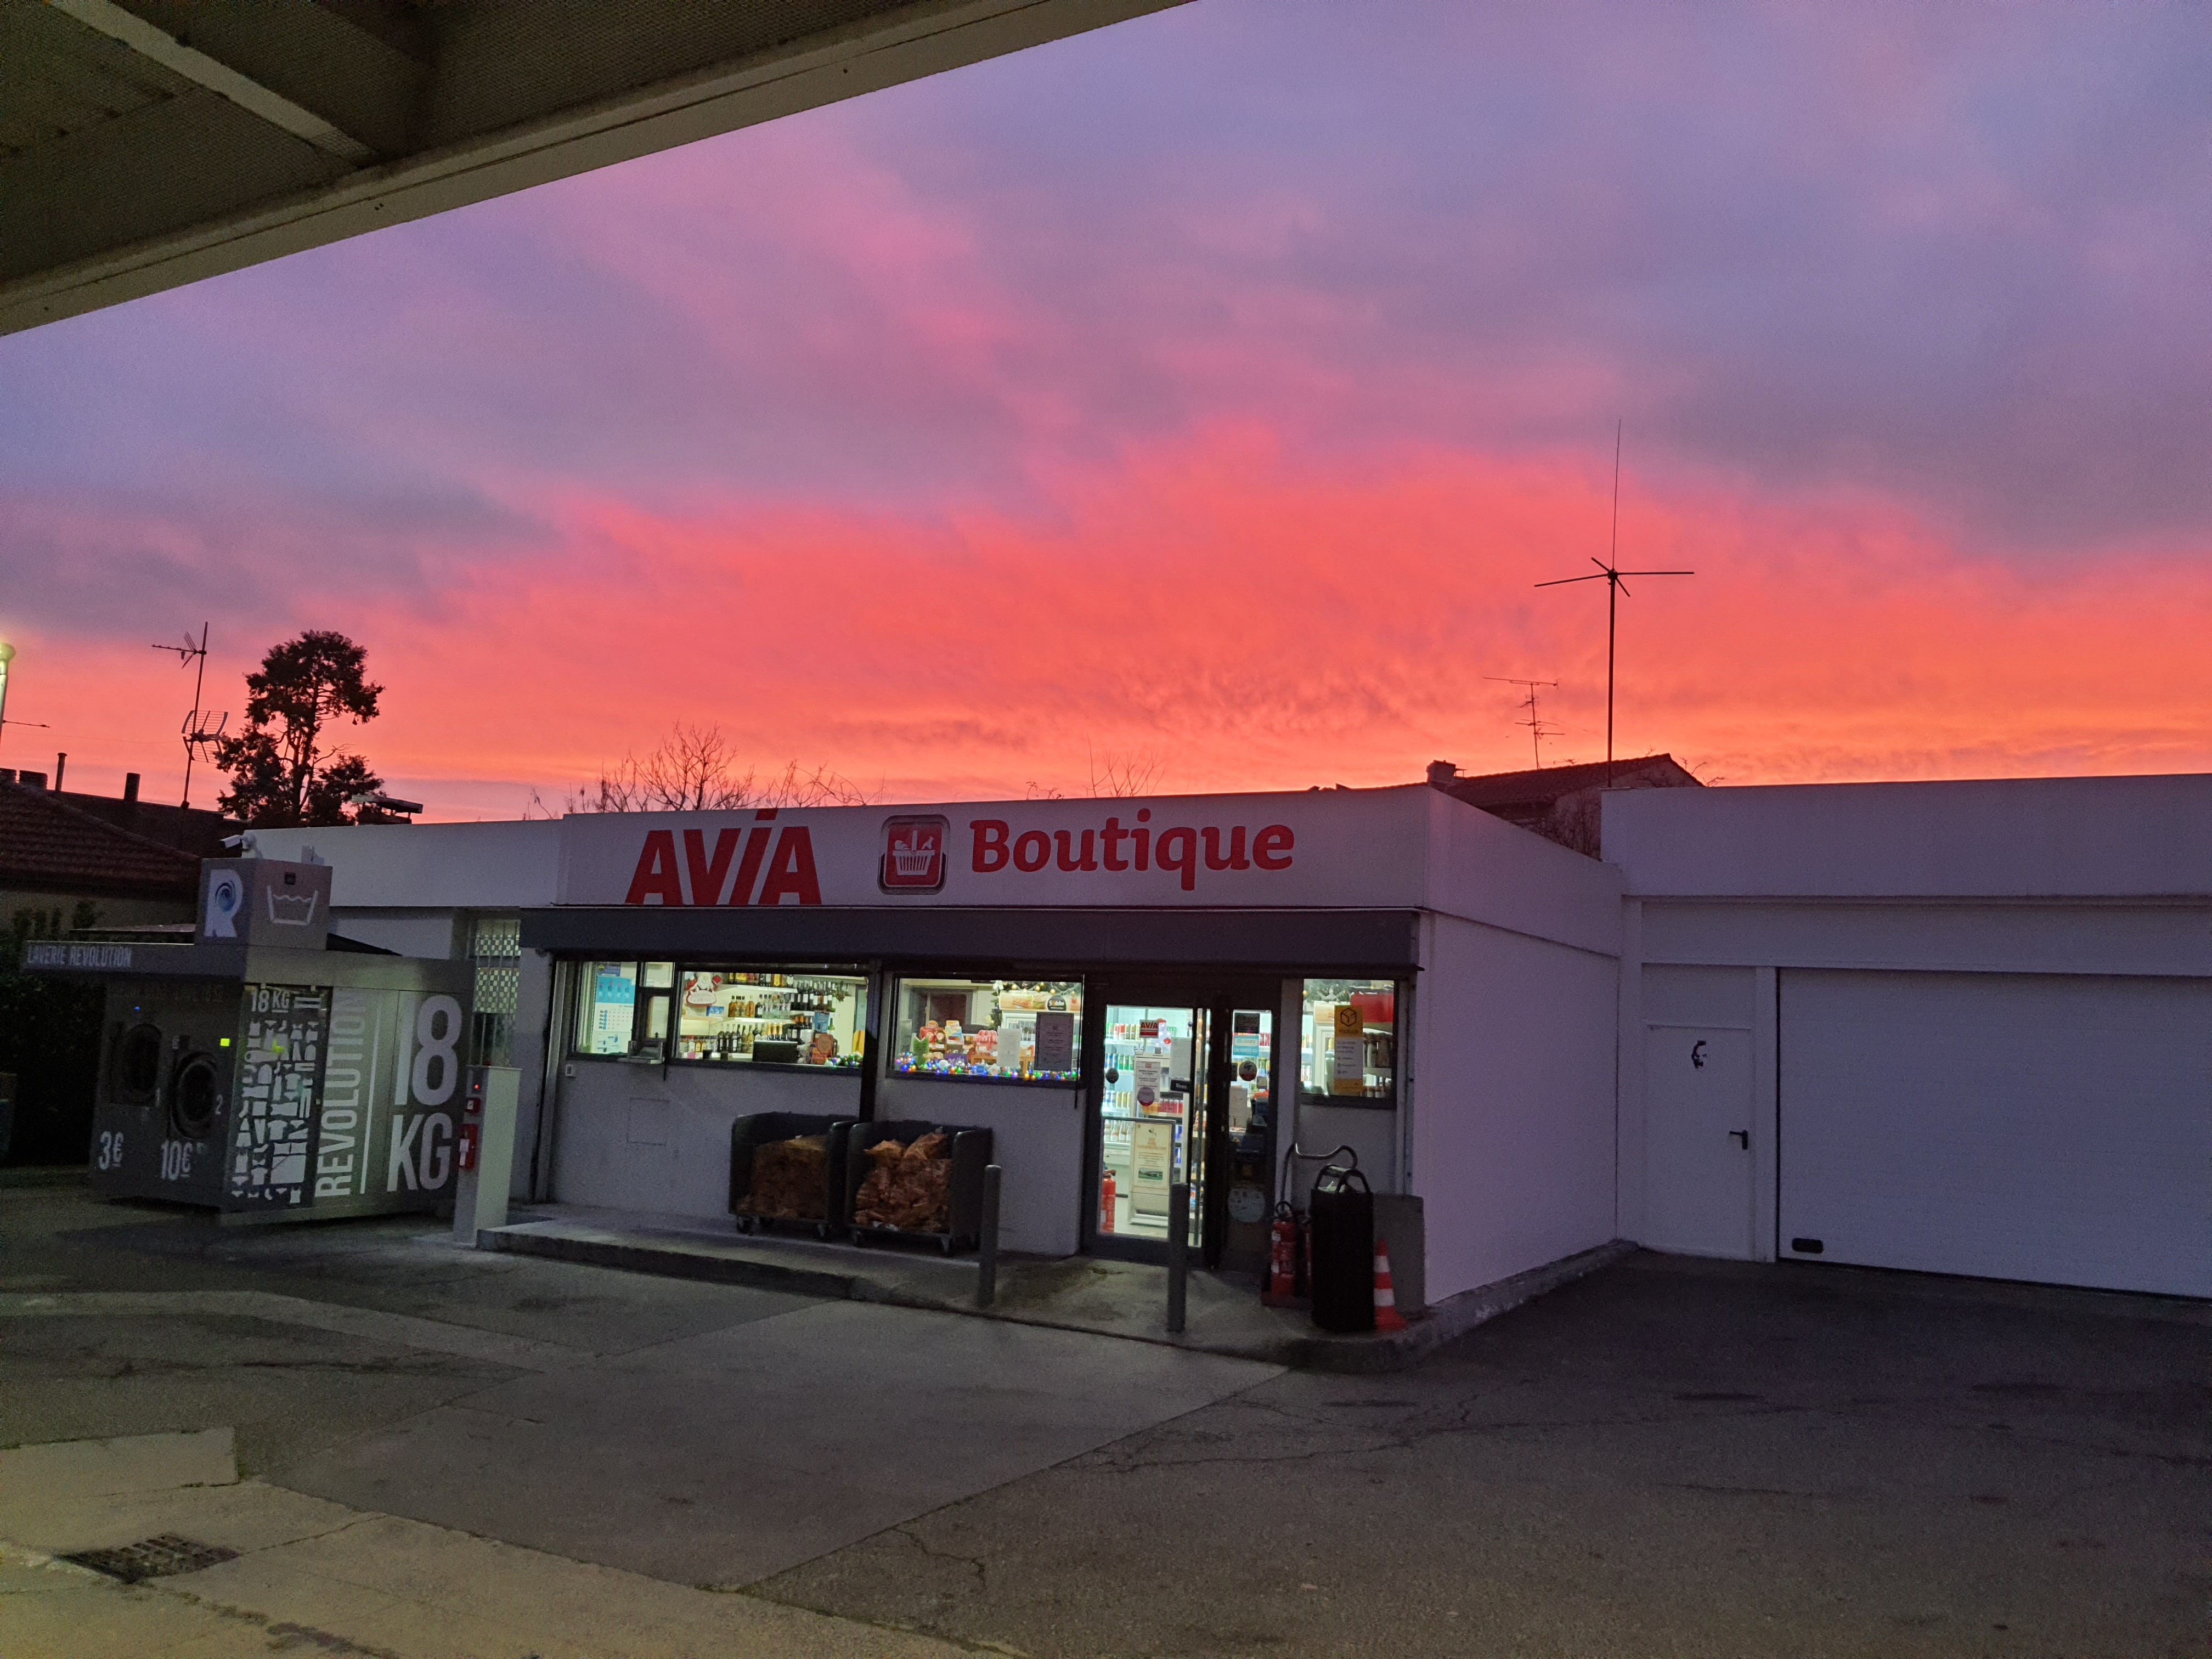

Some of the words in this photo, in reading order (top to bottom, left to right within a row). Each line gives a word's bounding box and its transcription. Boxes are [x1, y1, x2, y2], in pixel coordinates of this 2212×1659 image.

[969, 808, 1295, 891] Boutique
[27, 945, 66, 964] LAVERIE
[70, 946, 132, 967] REVOLUTION
[251, 989, 269, 1012] 18
[272, 991, 291, 1009] KG
[394, 991, 462, 1106] 18
[314, 990, 367, 1197] REVOLUTION
[386, 1112, 453, 1192] KG
